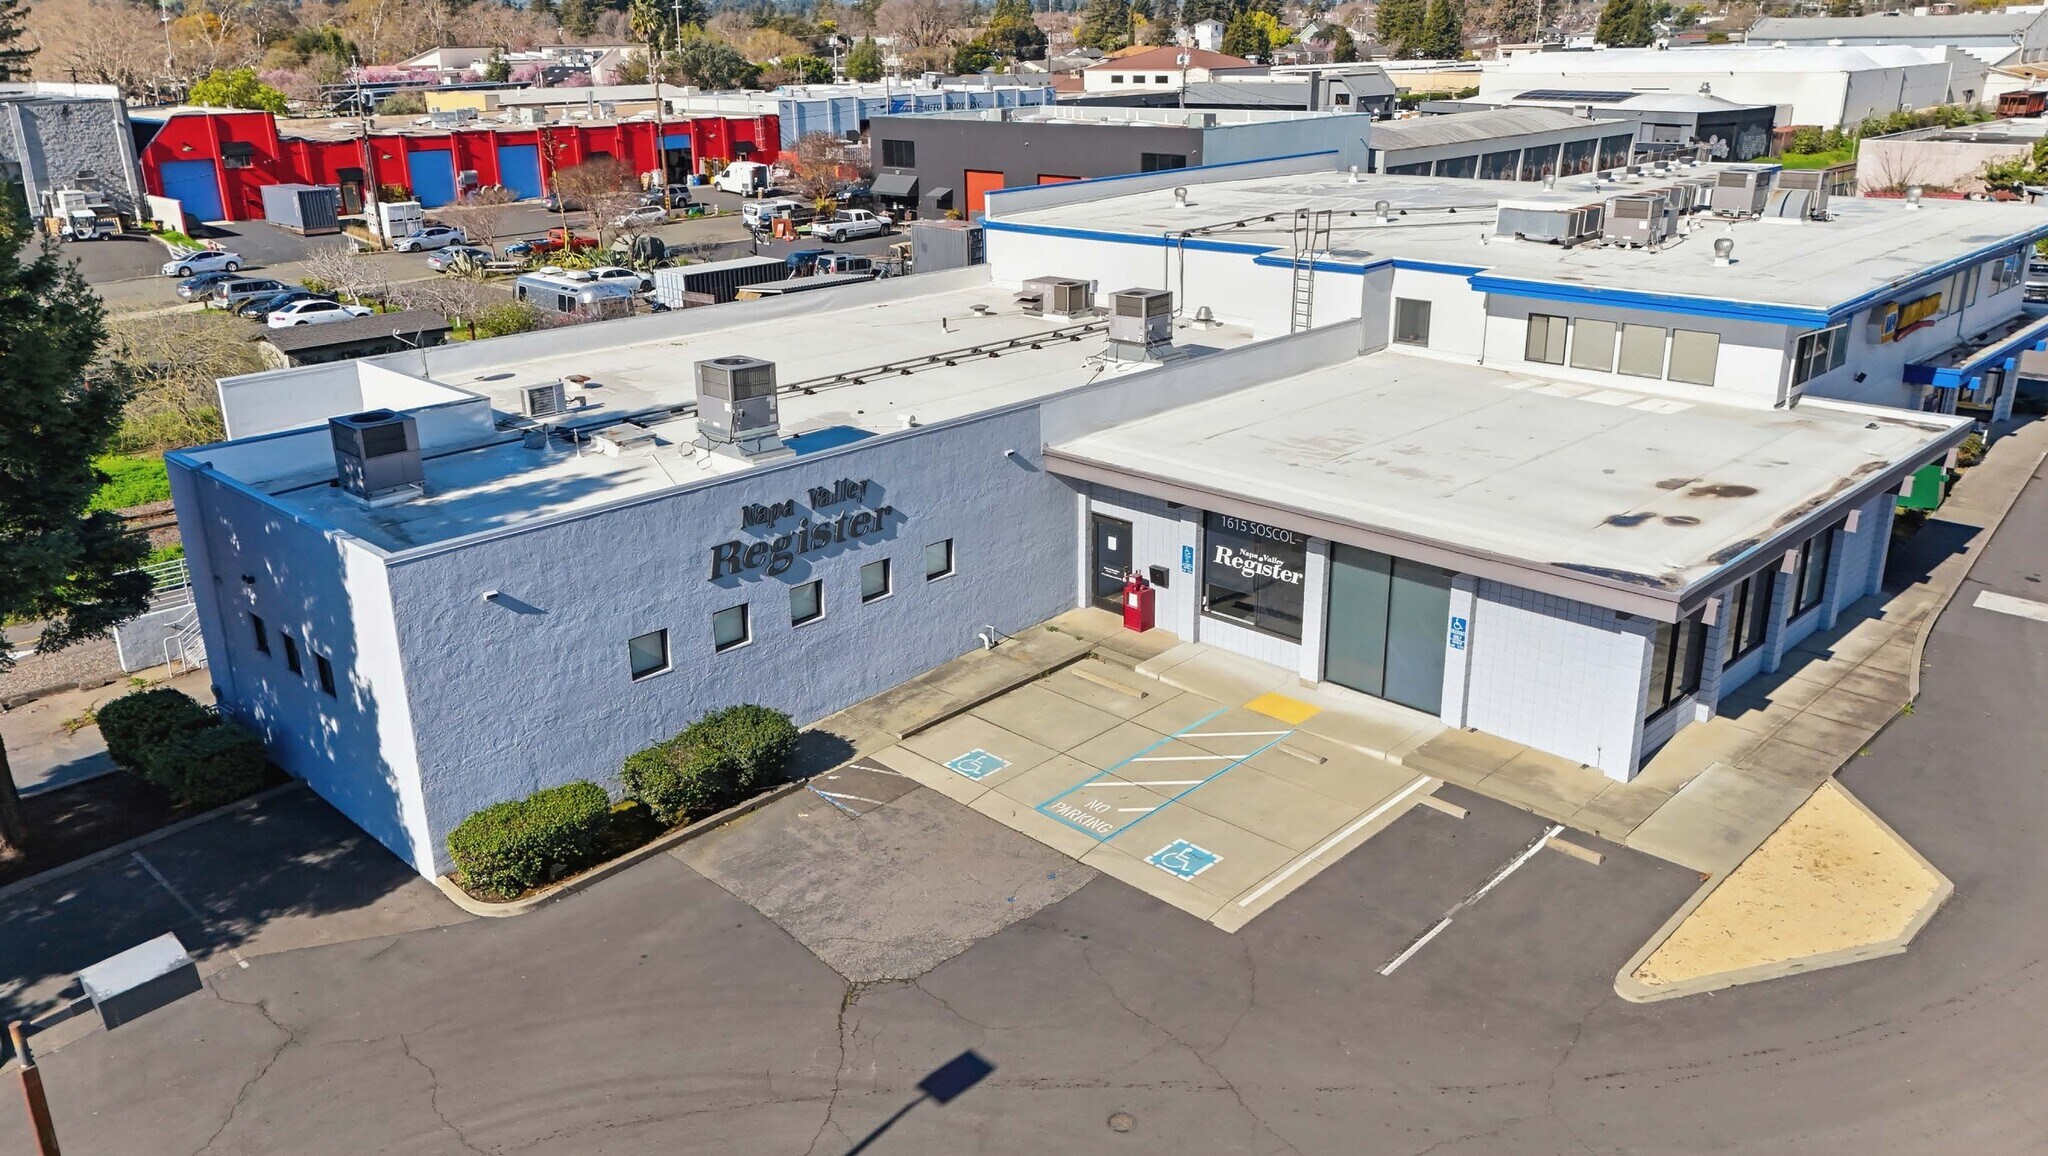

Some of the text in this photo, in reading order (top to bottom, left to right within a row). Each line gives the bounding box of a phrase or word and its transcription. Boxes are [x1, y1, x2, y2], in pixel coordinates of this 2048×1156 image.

[922, 102, 942, 112] AUTO
[739, 477, 869, 530] Napa Valley
[707, 504, 893, 582] Register
[1221, 516, 1296, 545] 1615 SOSCOL
[1213, 545, 1304, 585] Register
[1239, 548, 1285, 566] Napa Valley
[1051, 801, 1113, 833] PARKING
[1084, 799, 1111, 813] NO
